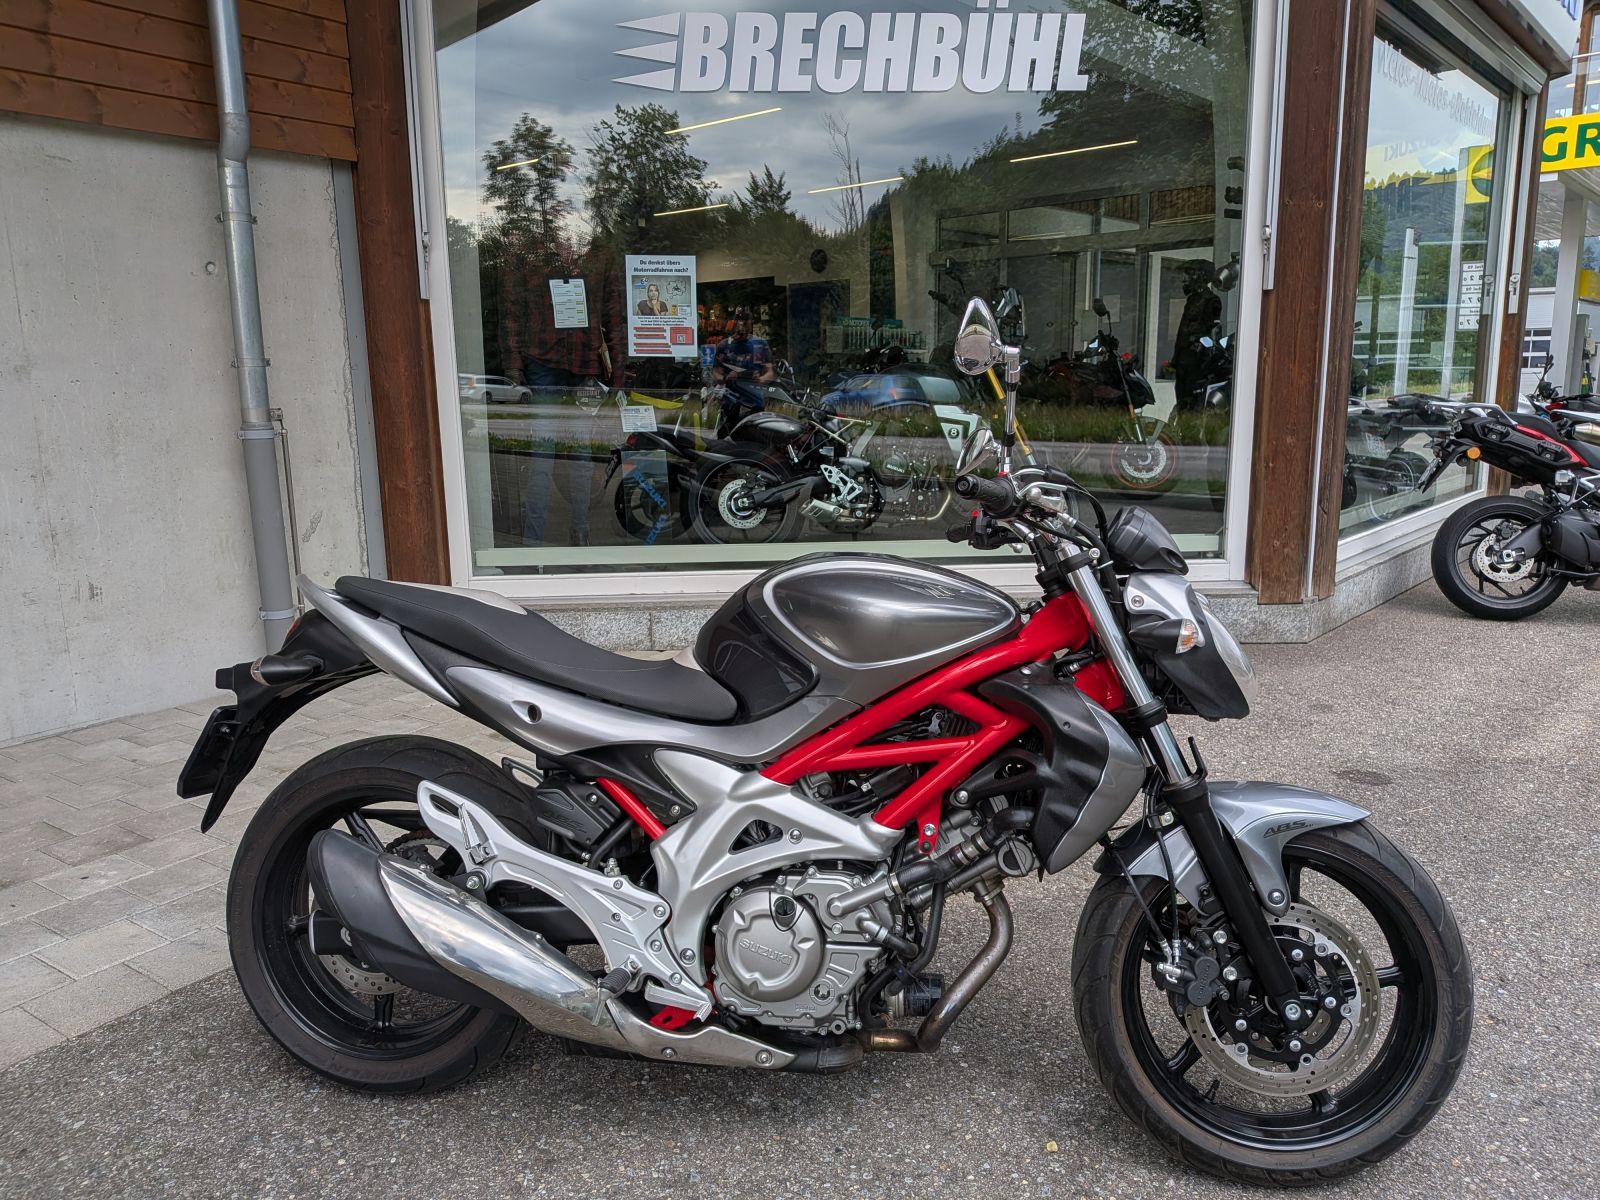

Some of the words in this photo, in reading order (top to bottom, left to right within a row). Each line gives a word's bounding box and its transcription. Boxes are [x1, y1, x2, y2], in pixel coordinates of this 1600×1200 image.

[679, 0, 1089, 93] BRECHBÜHL
[1263, 819, 1309, 839] ABS
[739, 938, 793, 966] SUZUKI
